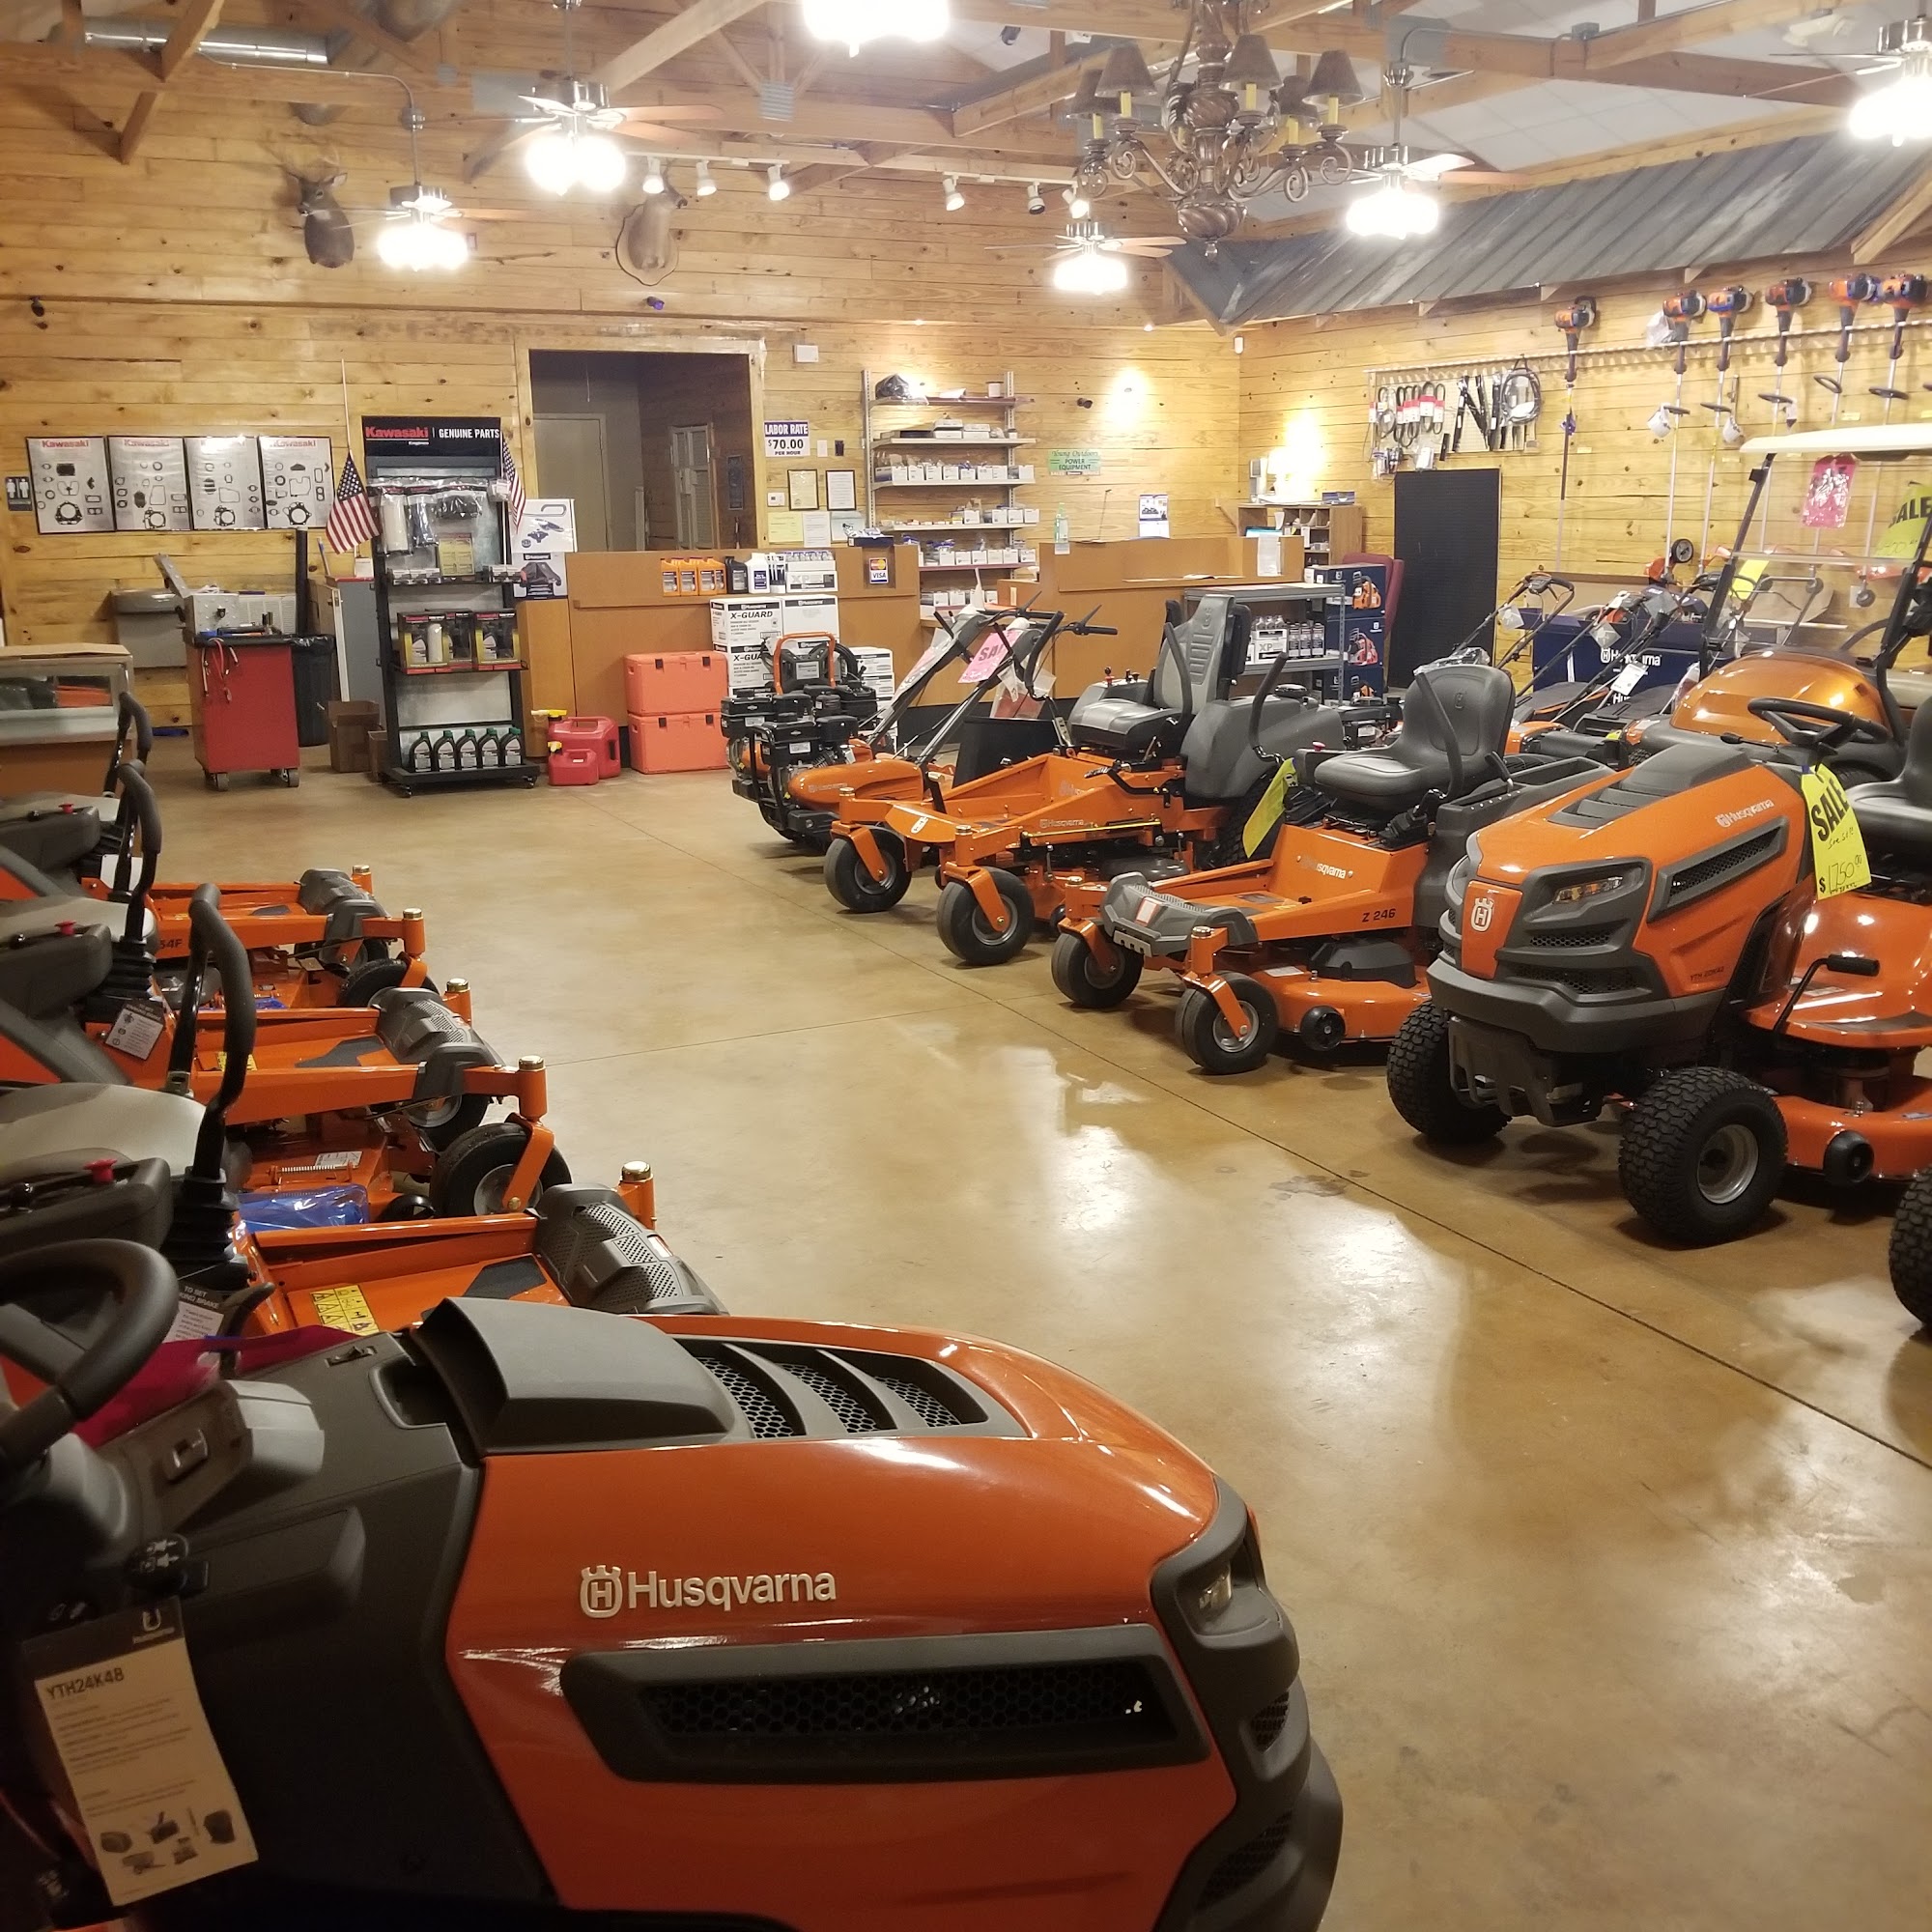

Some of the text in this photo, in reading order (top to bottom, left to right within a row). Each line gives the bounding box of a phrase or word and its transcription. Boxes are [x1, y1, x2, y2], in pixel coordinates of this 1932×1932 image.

[365, 426, 499, 439] Kawasaki GENUINE PARTS
[765, 424, 808, 435] LABOR RATE
[768, 439, 804, 449] $70.00
[730, 611, 773, 619] X-GUARD
[733, 652, 762, 662] X-GUA
[1725, 799, 1775, 823] Husqvarna
[1811, 778, 1850, 841] SALE
[1362, 908, 1396, 923] Z 246
[193, 1289, 208, 1297] SET
[196, 1297, 219, 1309] BRAKE
[627, 1571, 837, 1611] Husqvarna
[46, 1667, 125, 1700] YTH24K48
